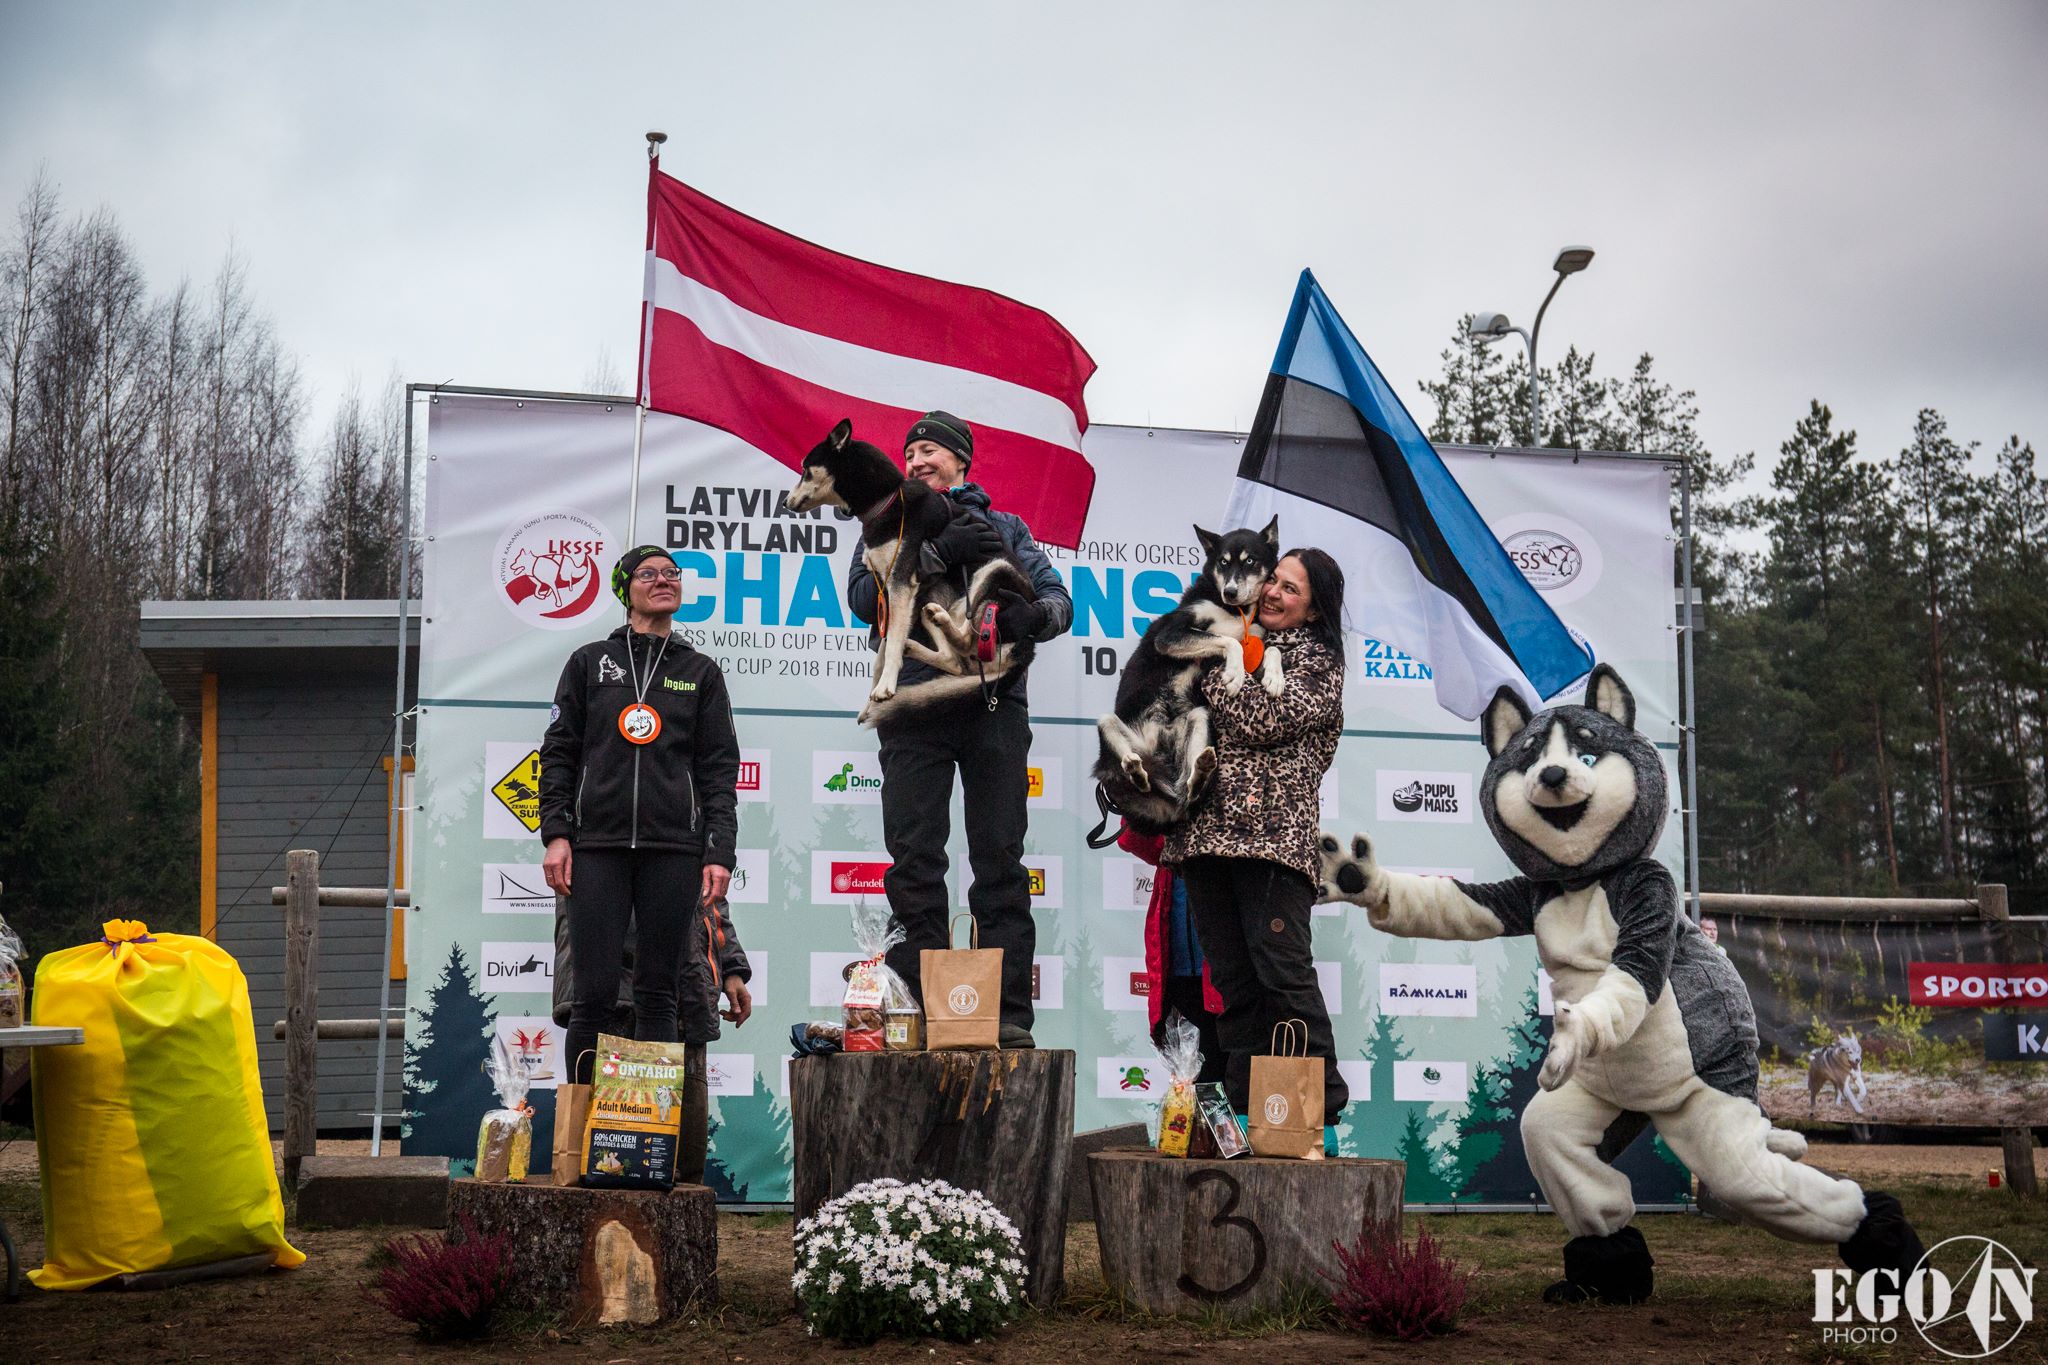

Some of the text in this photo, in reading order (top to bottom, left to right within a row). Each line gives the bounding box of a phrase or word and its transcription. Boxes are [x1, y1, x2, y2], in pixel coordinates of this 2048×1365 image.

[543, 513, 567, 521] SPORTA
[666, 519, 838, 555] DRYLAND
[549, 539, 604, 556] LKSSF
[1075, 541, 1128, 562] PARK
[1135, 544, 1200, 566] OGRES
[671, 551, 871, 629] CHA
[713, 630, 775, 649] WORLD
[782, 633, 817, 650] CUP
[737, 657, 772, 675] CUP
[779, 660, 819, 677] 2018
[826, 661, 874, 678] FINAL
[663, 676, 696, 691] Ingūna
[851, 775, 881, 788] Dino
[1424, 783, 1455, 799] PUPU
[1424, 797, 1459, 813] MAISS
[487, 961, 518, 977] Divi
[2017, 1024, 2048, 1054] K
[619, 1063, 677, 1080] ONTARIO
[596, 1100, 652, 1115] Adult Medium
[594, 1132, 637, 1144] 60% CHICKEN
[1176, 1168, 1267, 1301] 3
